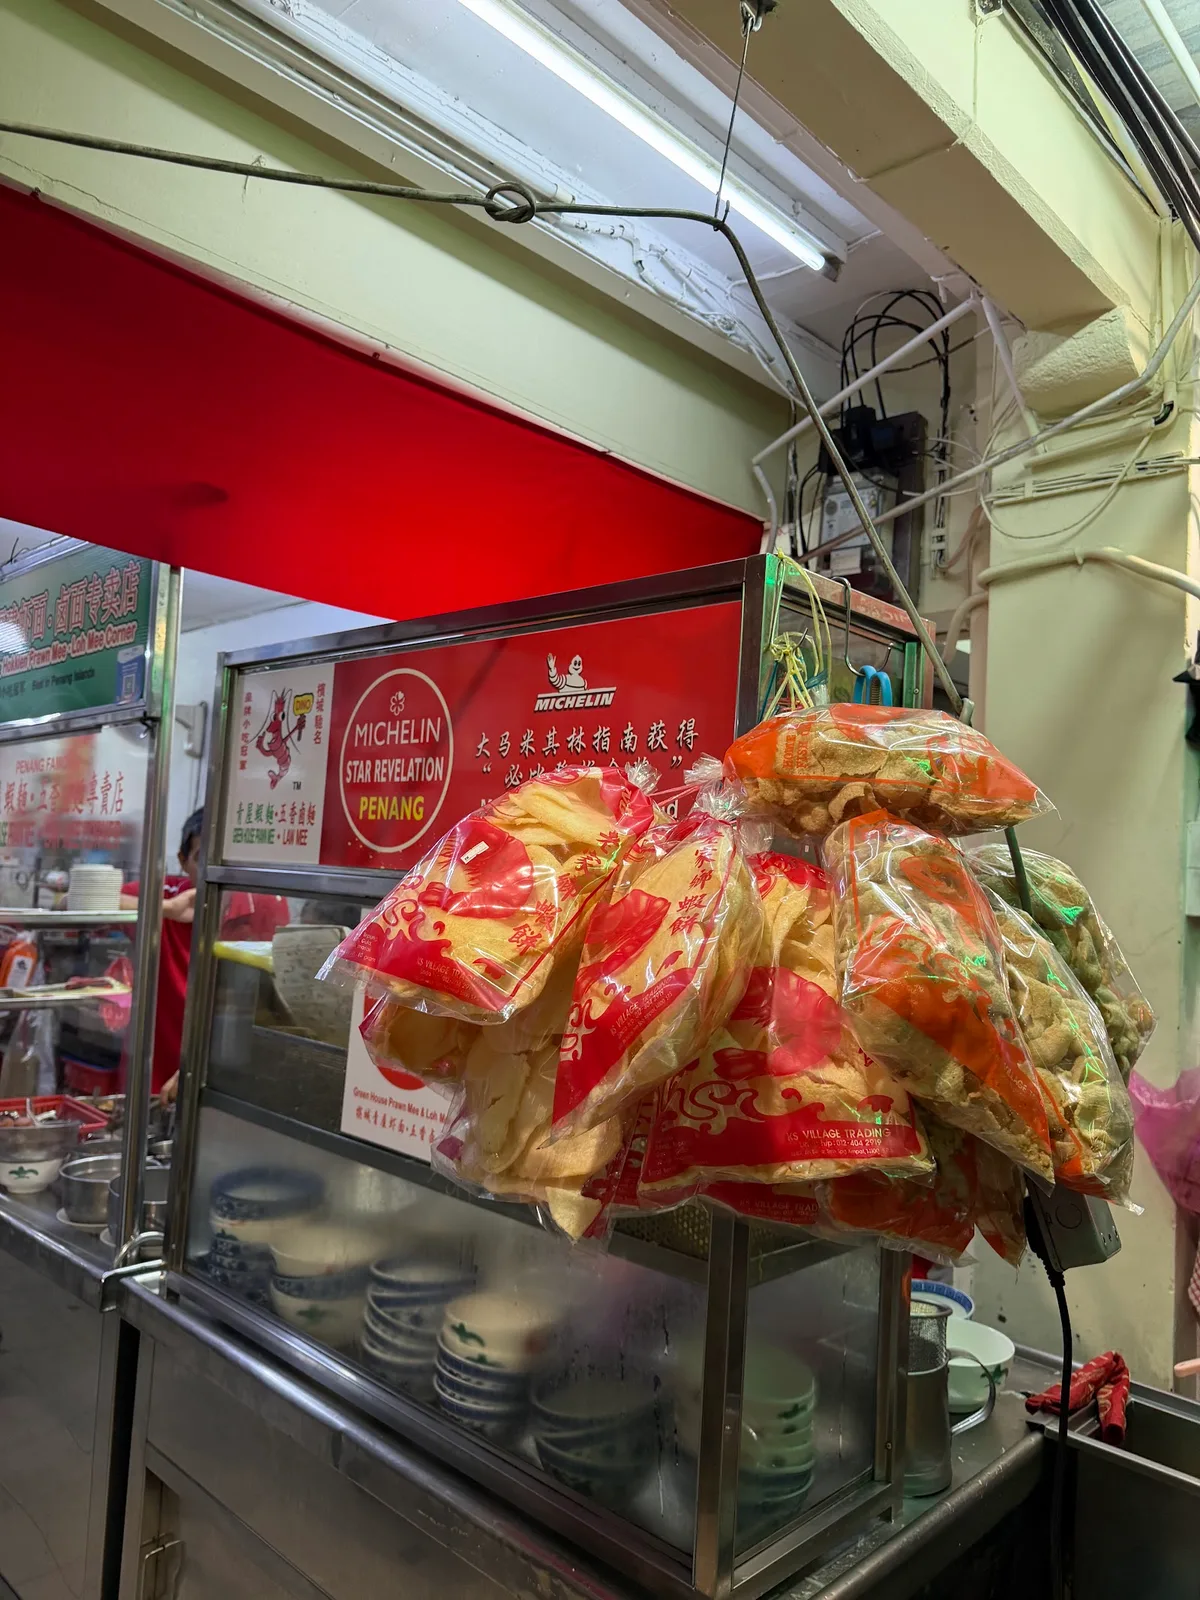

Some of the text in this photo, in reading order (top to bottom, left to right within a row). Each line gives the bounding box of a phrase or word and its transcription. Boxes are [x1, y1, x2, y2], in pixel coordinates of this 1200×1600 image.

[51, 641, 66, 661] Mee
[87, 629, 104, 651] Mee
[105, 621, 137, 647] Corner
[534, 691, 615, 712] MICHELIN
[354, 716, 441, 747] MICHELIN
[475, 718, 699, 758] 大马米其林指南获得
[346, 756, 444, 783] STAR REVELATION
[359, 796, 425, 820] PENANG
[407, 1102, 419, 1115] Mee
[802, 1129, 841, 1139] VILLAGE
[844, 1128, 891, 1139] TRADING
